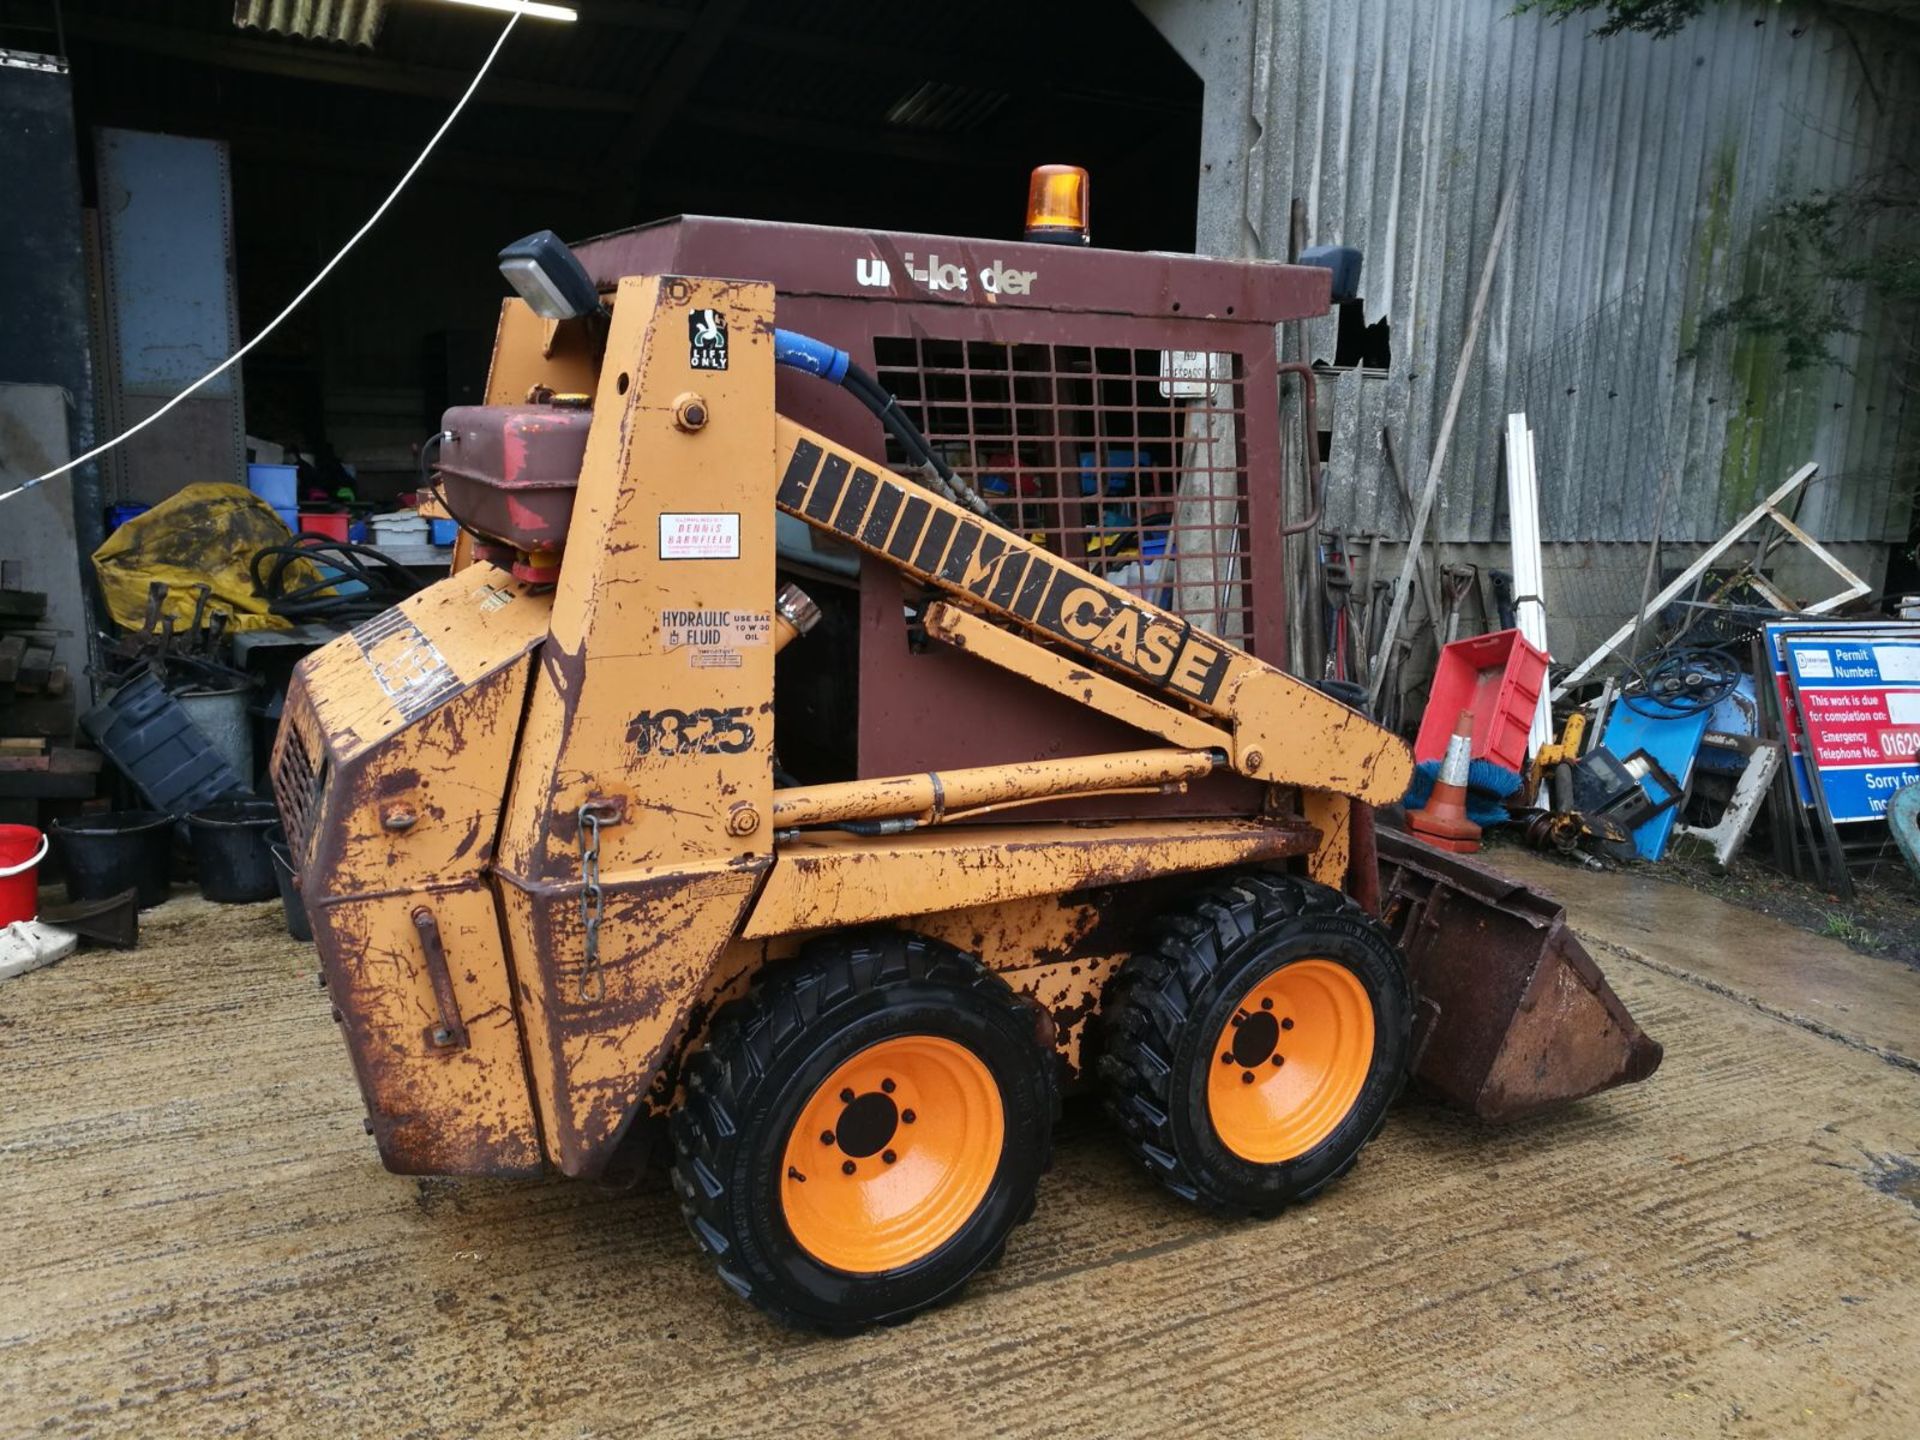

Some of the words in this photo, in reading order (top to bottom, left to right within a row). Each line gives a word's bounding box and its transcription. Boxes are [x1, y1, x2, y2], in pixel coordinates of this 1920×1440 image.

[693, 349, 725, 359] LIFT
[691, 358, 727, 368] ONLY
[662, 611, 730, 627] HYDRAULIC
[687, 629, 721, 645] FLUID
[1060, 587, 1218, 695] CASE
[1835, 649, 1869, 661] Permit
[1835, 665, 1878, 679] Number:
[1808, 694, 1829, 706] This
[1830, 694, 1850, 706] work
[1852, 694, 1860, 706] is
[1861, 694, 1878, 706] due
[1808, 710, 1823, 722] for
[1824, 710, 1871, 723] completion
[1872, 712, 1887, 722] on:
[624, 708, 756, 757] 1825
[1821, 731, 1868, 745] Emergency
[1817, 747, 1862, 761] Telephone
[1863, 747, 1880, 758] No:
[1865, 773, 1900, 790] Sorry
[1902, 772, 1920, 787] for
